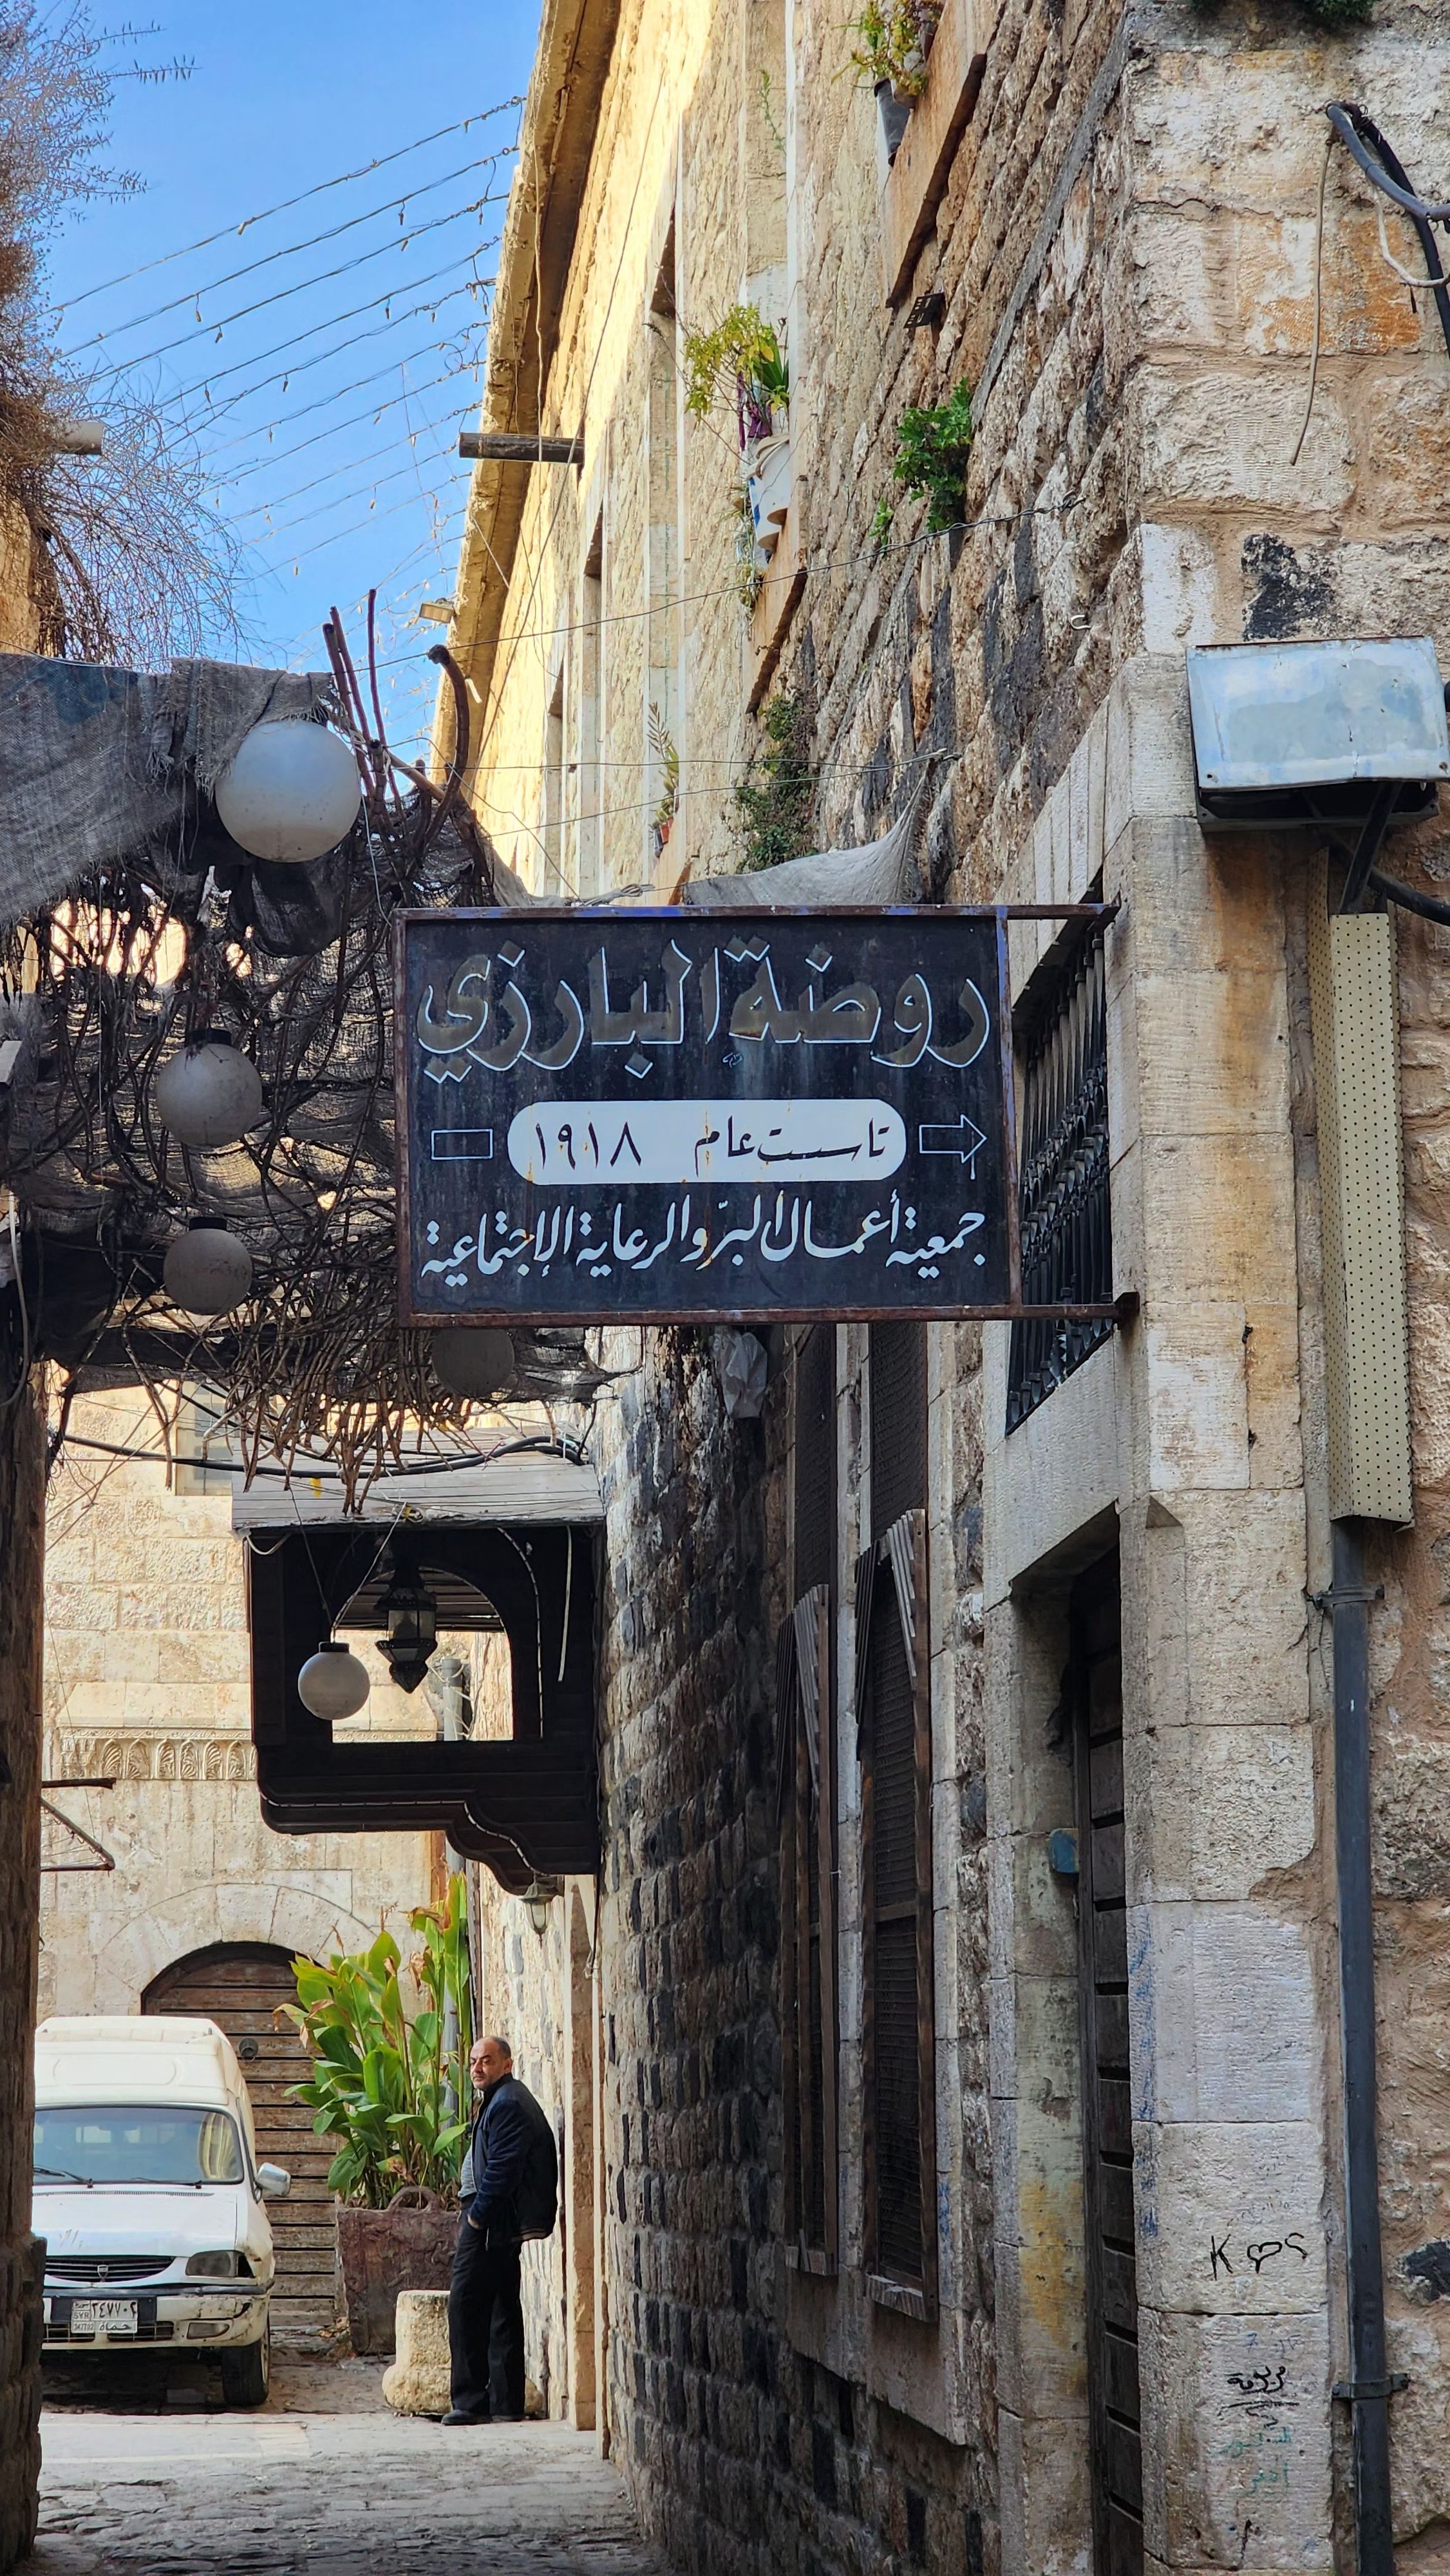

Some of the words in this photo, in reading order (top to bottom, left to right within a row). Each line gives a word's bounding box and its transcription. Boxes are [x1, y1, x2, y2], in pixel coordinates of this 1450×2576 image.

[416, 938, 720, 1084] البارزي
[724, 936, 990, 1069] روضة
[534, 1121, 642, 1170] ١٩١٨
[694, 1115, 756, 1178] عام
[576, 1193, 709, 1278] والرعاية
[760, 1188, 900, 1262] أعمال
[885, 1206, 986, 1279] جمعية
